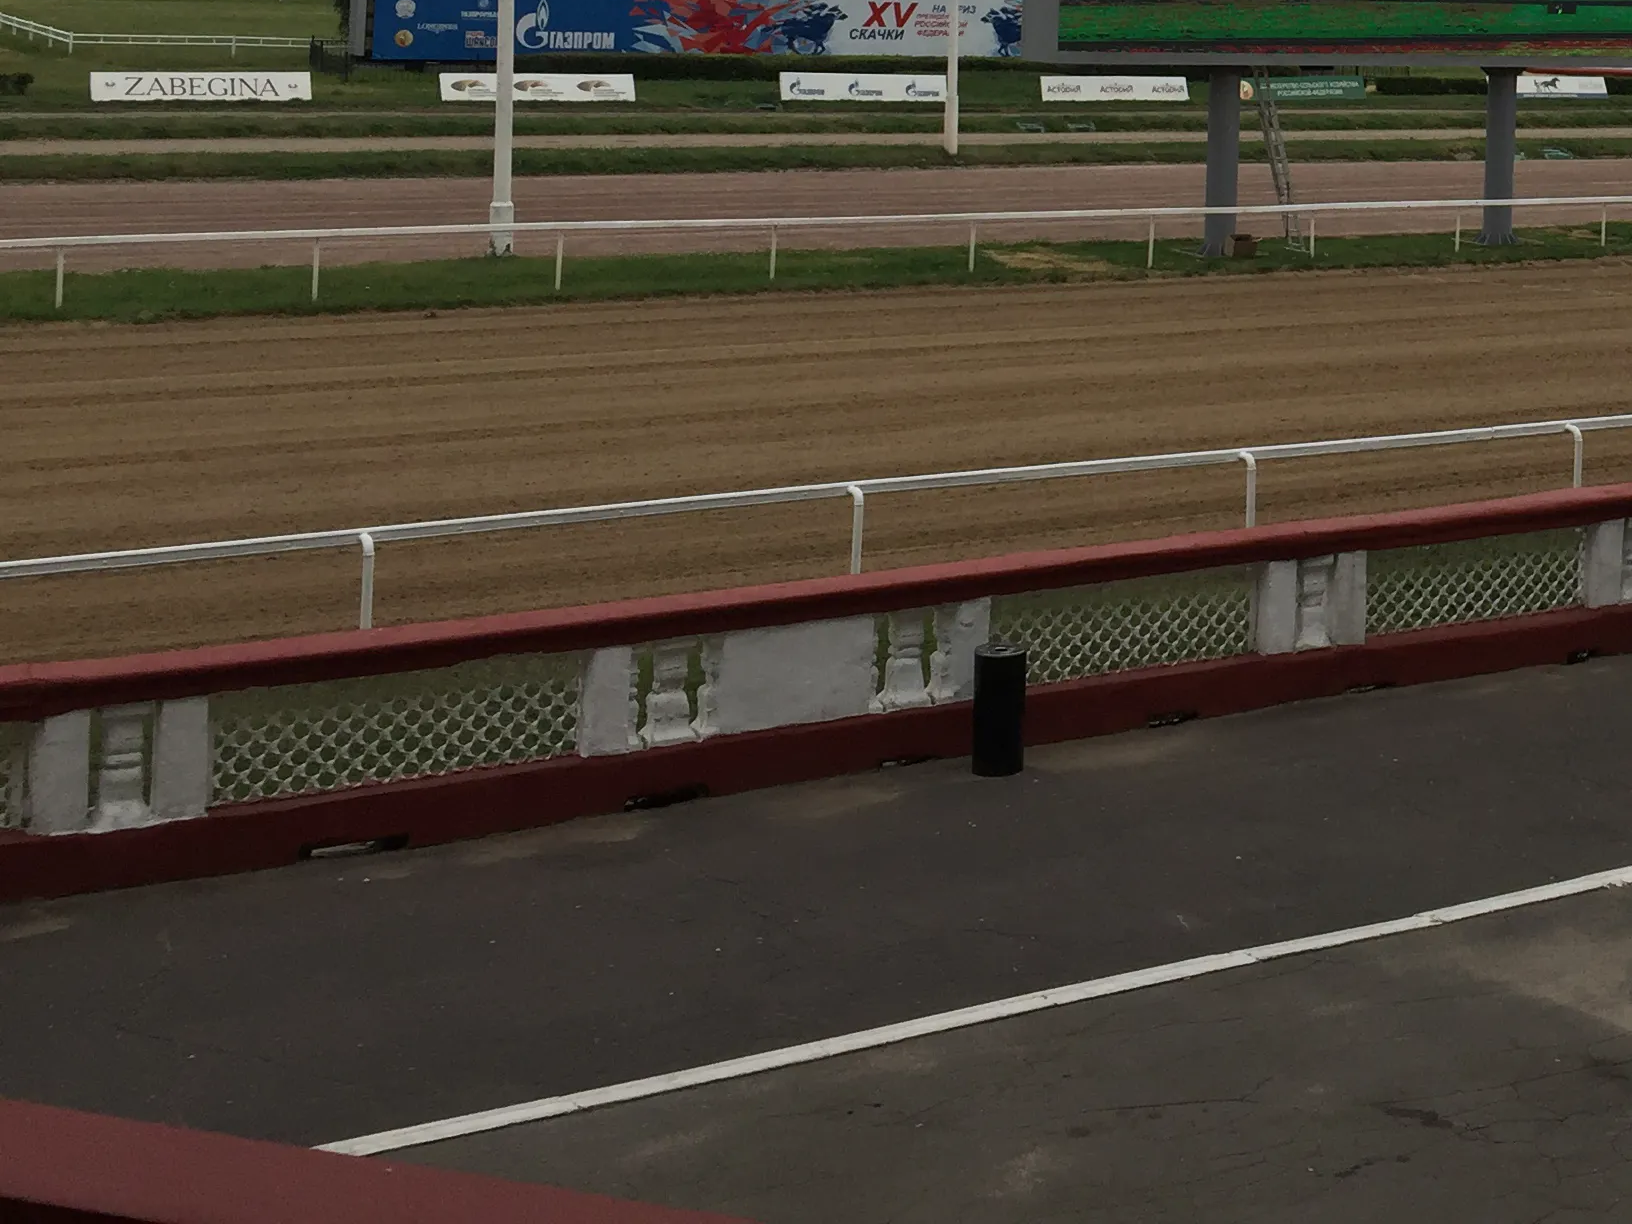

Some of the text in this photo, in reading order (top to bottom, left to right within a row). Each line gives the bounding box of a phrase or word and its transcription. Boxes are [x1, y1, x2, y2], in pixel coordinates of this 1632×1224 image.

[862, 1, 919, 28] XV
[931, 4, 947, 14] НА
[549, 31, 615, 50] ГАЗПРОМ
[850, 28, 905, 41] СКАЧКИ
[124, 76, 280, 97] ZABEGINA
